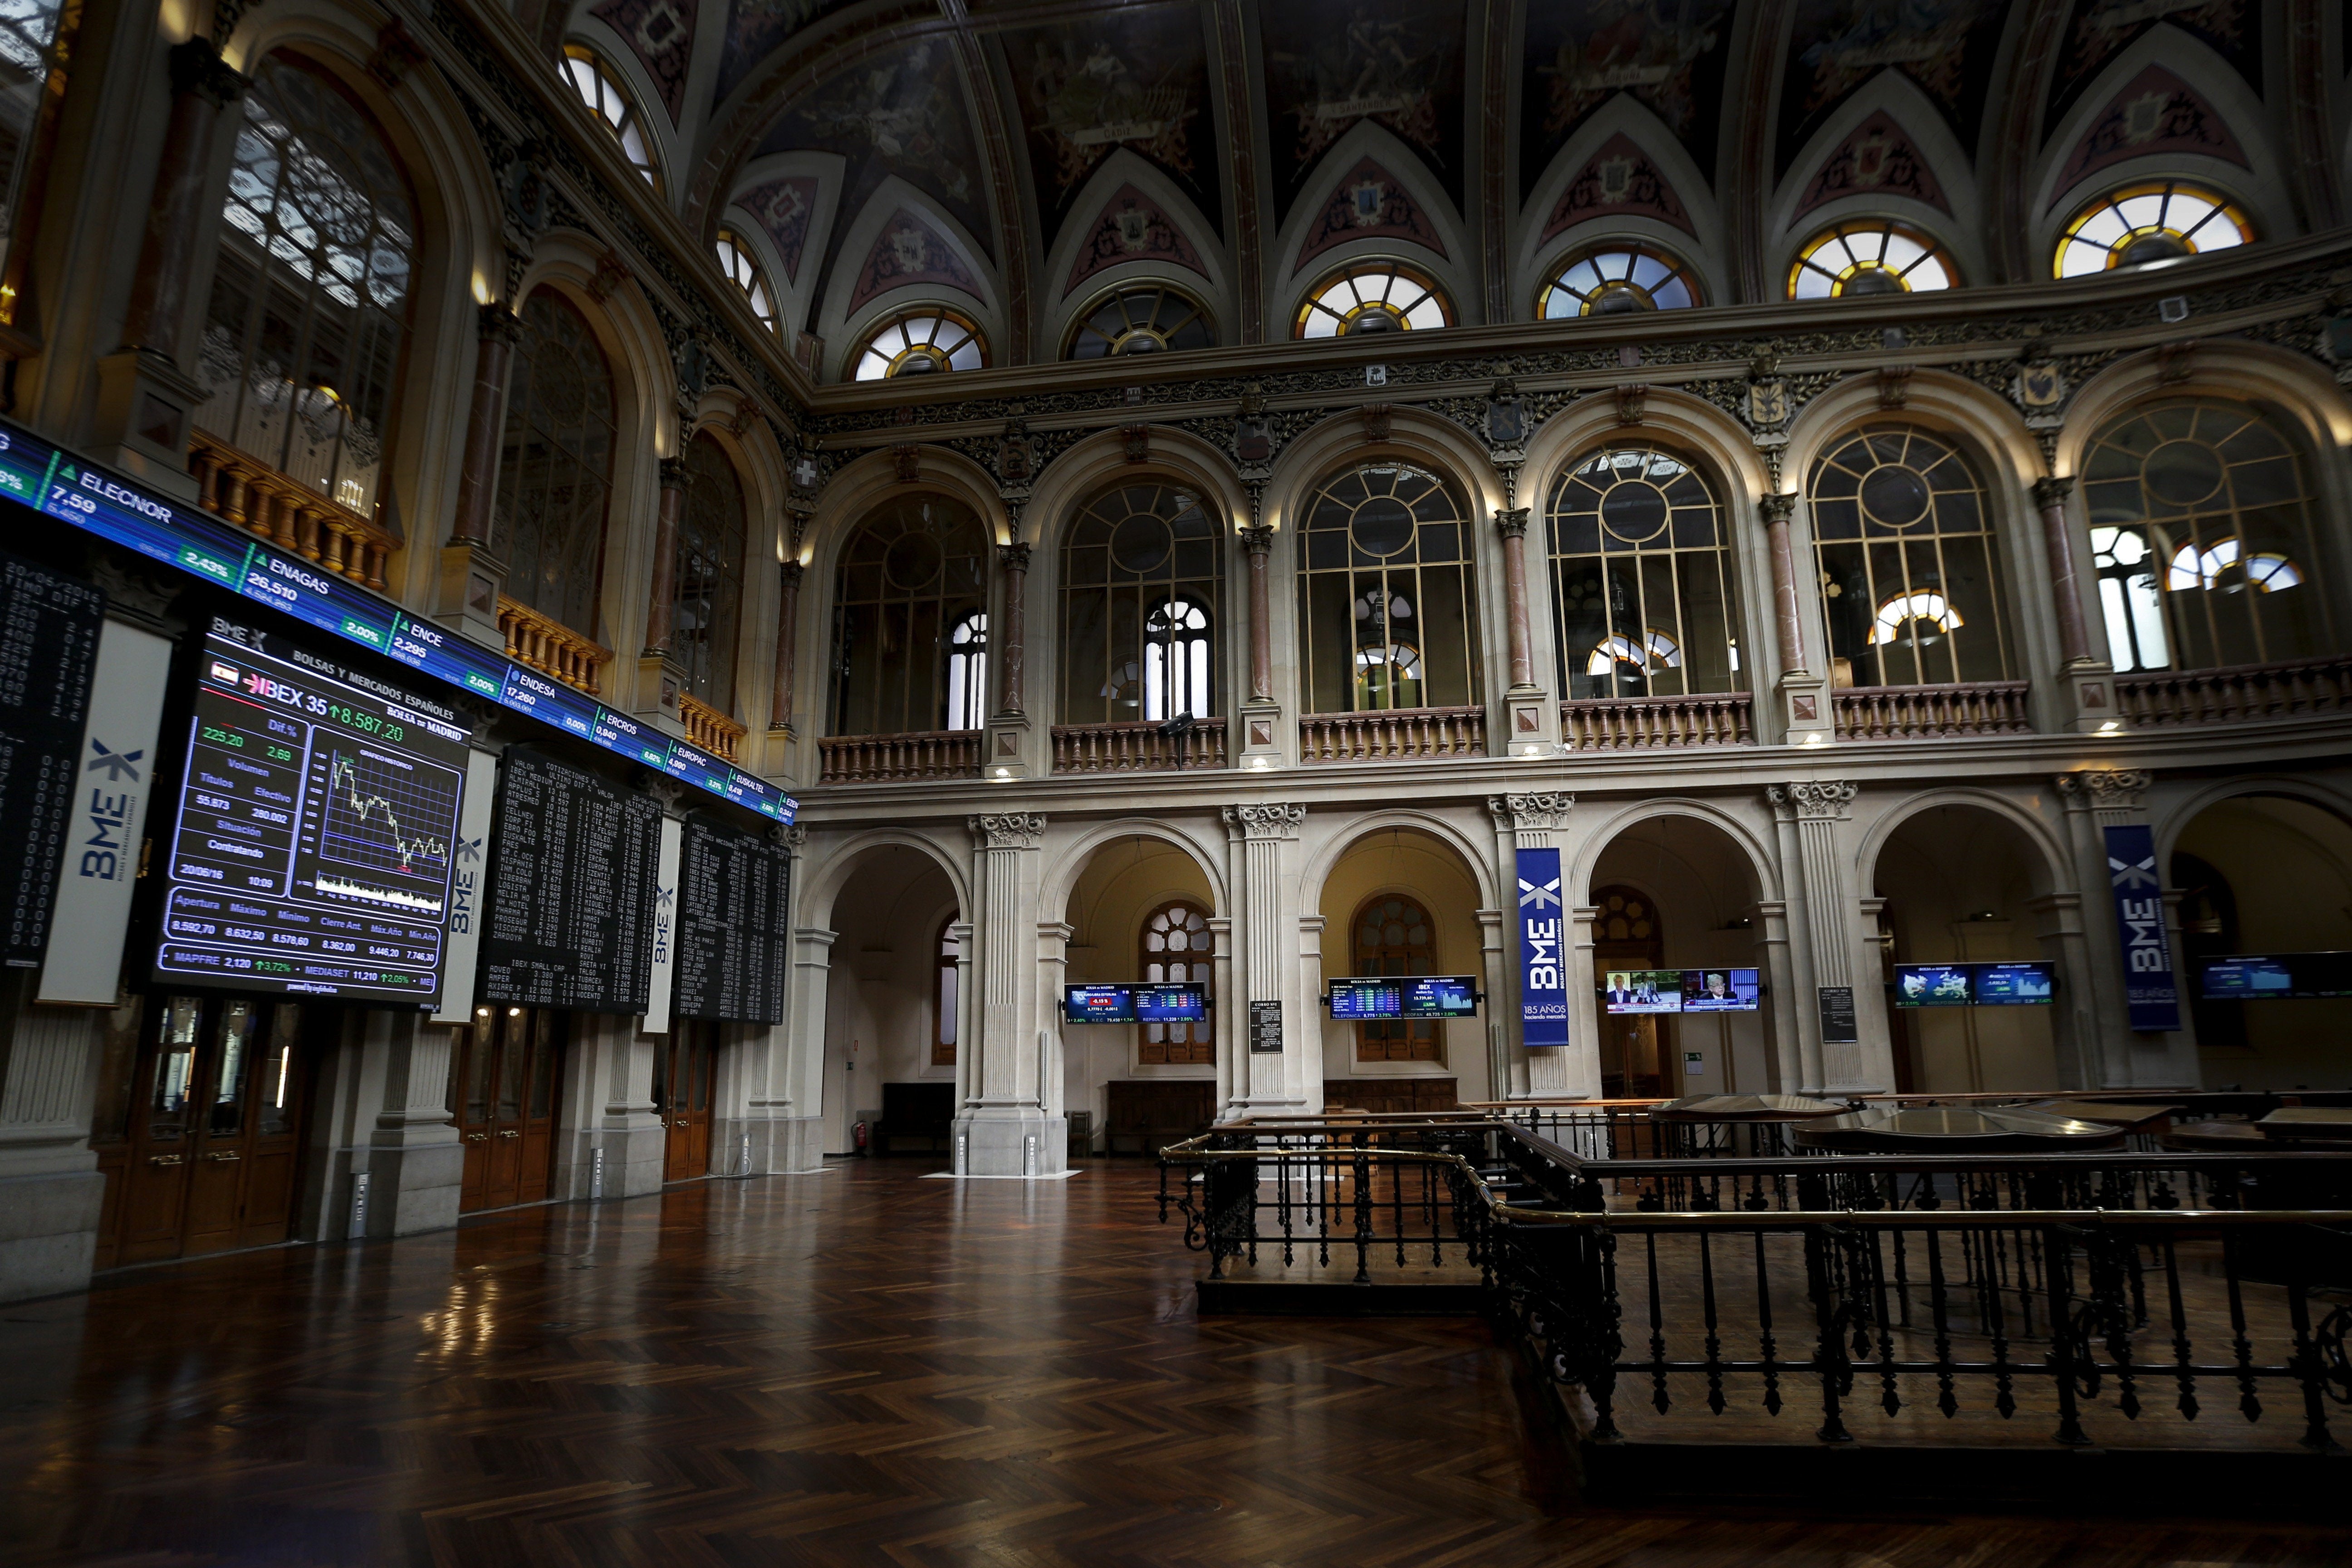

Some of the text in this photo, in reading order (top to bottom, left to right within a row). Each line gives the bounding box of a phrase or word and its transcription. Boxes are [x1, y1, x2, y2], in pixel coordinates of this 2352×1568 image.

[1104, 127, 1131, 138] CADIZ
[51, 485, 97, 514] 7,59
[79, 471, 172, 524] ELECNOR
[185, 552, 228, 578] 2,43%
[269, 558, 330, 595] ENAGAS
[246, 572, 298, 602] 26,510
[51, 590, 82, 608] DIF
[212, 616, 249, 642] BME
[346, 622, 378, 643] 2,00%
[410, 624, 443, 647] ENCE
[393, 637, 426, 658] 2,295
[293, 650, 454, 720] BOLSAS Y MERCADOS ESPAÑOLES
[469, 676, 495, 694] 2,00%
[519, 674, 556, 699] ENDESA
[507, 686, 536, 706] 17,260
[260, 677, 404, 742] IBEX 35 8.587,20
[386, 706, 463, 742] BOLSA DE MADRID
[566, 718, 587, 732] 0,00%
[607, 715, 637, 735] ERCROS
[596, 725, 617, 741] 0,940
[266, 745, 292, 761] 2,69
[644, 751, 661, 764] 6,82%
[677, 747, 707, 767] EUROPAC
[227, 758, 270, 778] Volumen
[514, 759, 589, 784] VALOR COTIZACIONES
[668, 758, 686, 771] 4,990
[509, 774, 540, 790] ALMIRALL
[510, 766, 567, 789] IBEX MEDIUM CAP
[549, 772, 571, 785] ULTIMO
[708, 779, 722, 790] 3,21%
[736, 775, 764, 794] EUSKALTEL
[253, 786, 292, 803] Efectivo
[508, 782, 533, 796] APPLUS
[598, 789, 614, 800] VALOR
[728, 784, 743, 796] 8,418
[196, 794, 231, 810] 55.873
[506, 798, 519, 808] BME
[507, 790, 539, 805] ATRESMED
[505, 806, 534, 820] CELLNEX
[779, 807, 792, 818] 0,344
[80, 788, 127, 880] BME
[216, 819, 262, 838] Situación
[503, 823, 520, 833] EBRO
[502, 839, 519, 849] FAES
[503, 831, 535, 846] EUSKALTE
[207, 839, 264, 859] Contratando
[589, 847, 603, 856] ENCE
[500, 856, 533, 869] HISPANIA
[588, 855, 609, 865] ERCROS
[179, 864, 273, 888] 20/06/16 10:09
[499, 873, 532, 885] LIBERBAN
[497, 889, 519, 900] MELIA
[498, 881, 527, 893] LOGISTA
[451, 868, 473, 934] BME
[496, 897, 529, 910] NH HOTEL
[174, 894, 220, 910] Apertura
[230, 902, 267, 917] Máximo
[320, 917, 344, 929] Cierre
[495, 914, 528, 926] PROSEGUR
[493, 931, 522, 942] ZARDOYA
[494, 923, 527, 934] VISCOFAN
[2122, 898, 2164, 973] BME
[654, 912, 669, 964] BME
[322, 940, 356, 952] 8.362,00
[368, 946, 400, 958] 9.446,20
[407, 951, 435, 962] 7.746,30
[580, 945, 602, 954] REALIA
[1527, 918, 1558, 990] BME
[174, 952, 220, 965] MAPFRE
[223, 957, 252, 969] 2,120
[264, 961, 291, 972] 3,72%
[304, 965, 349, 978] MEDIASET
[353, 971, 378, 981] 11,210
[489, 965, 511, 974] ADVEO
[511, 959, 565, 973] IBEX SMALL CAP
[488, 973, 510, 983] AMPER
[578, 975, 602, 985] TUBACEX
[486, 991, 509, 1000] BARON
[577, 991, 601, 1000] VOCENTO
[1524, 1004, 1566, 1014] 185 AÑOS
